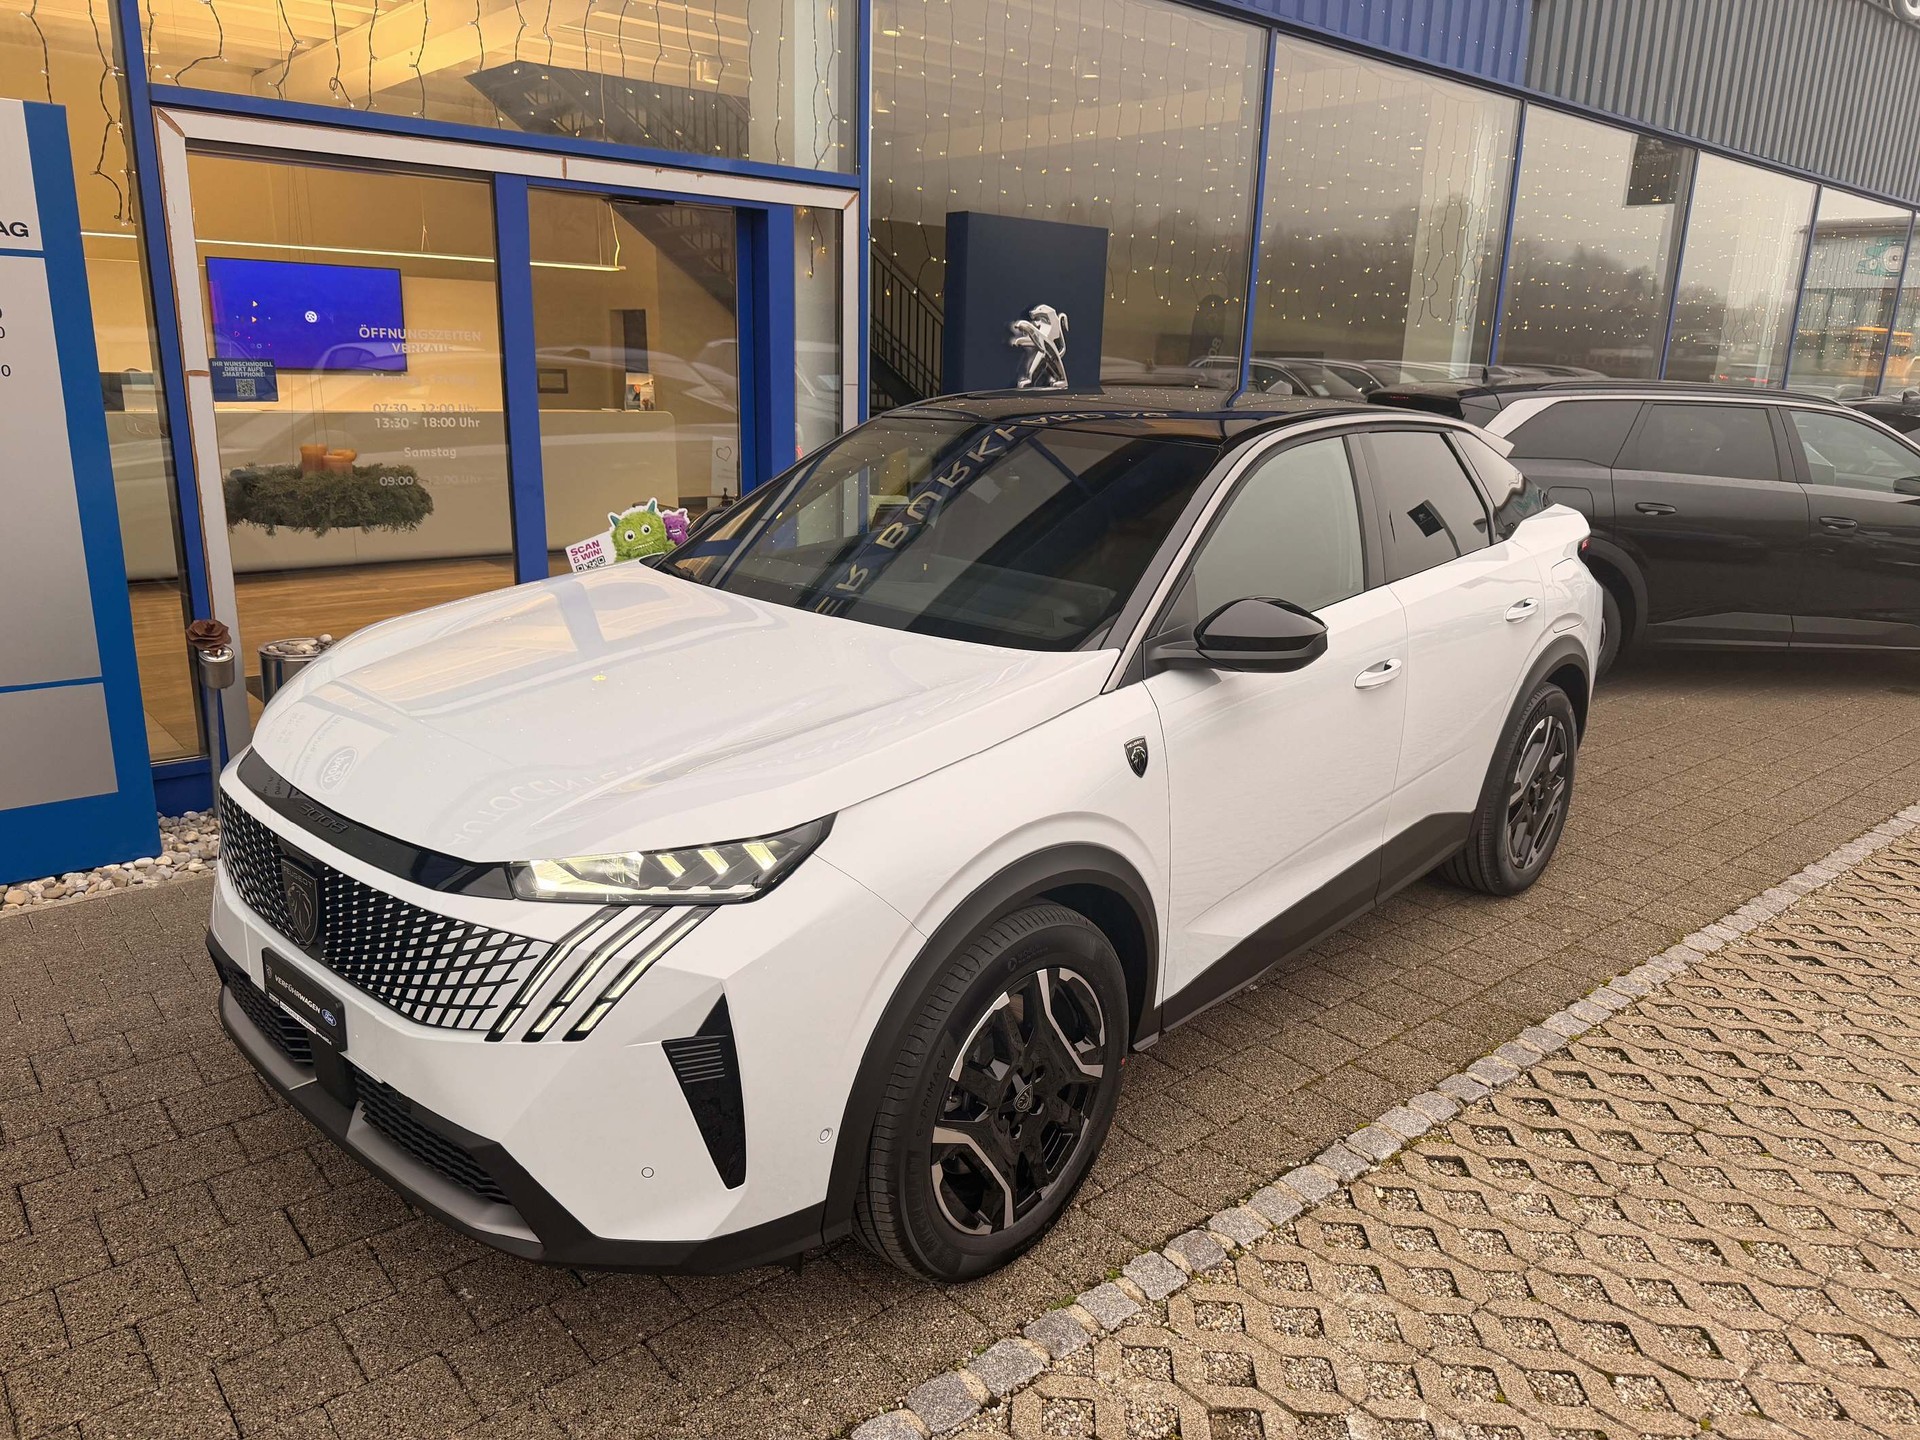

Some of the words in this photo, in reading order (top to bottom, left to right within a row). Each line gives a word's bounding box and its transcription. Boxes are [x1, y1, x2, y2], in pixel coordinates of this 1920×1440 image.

[0, 221, 29, 237] AG
[359, 324, 481, 341] ÖFFNUNGSZEITEN
[373, 403, 408, 414] 07:30
[421, 403, 455, 414] 12:00
[374, 417, 410, 429] 13:30
[422, 416, 456, 428] 18:00
[459, 416, 481, 428] Uhr
[404, 446, 457, 459] Samstag
[379, 475, 414, 487] 09:00
[570, 540, 600, 556] SCAN
[580, 547, 602, 561] WIN!
[300, 803, 348, 834] 3008
[282, 865, 313, 889] PEUGEOT
